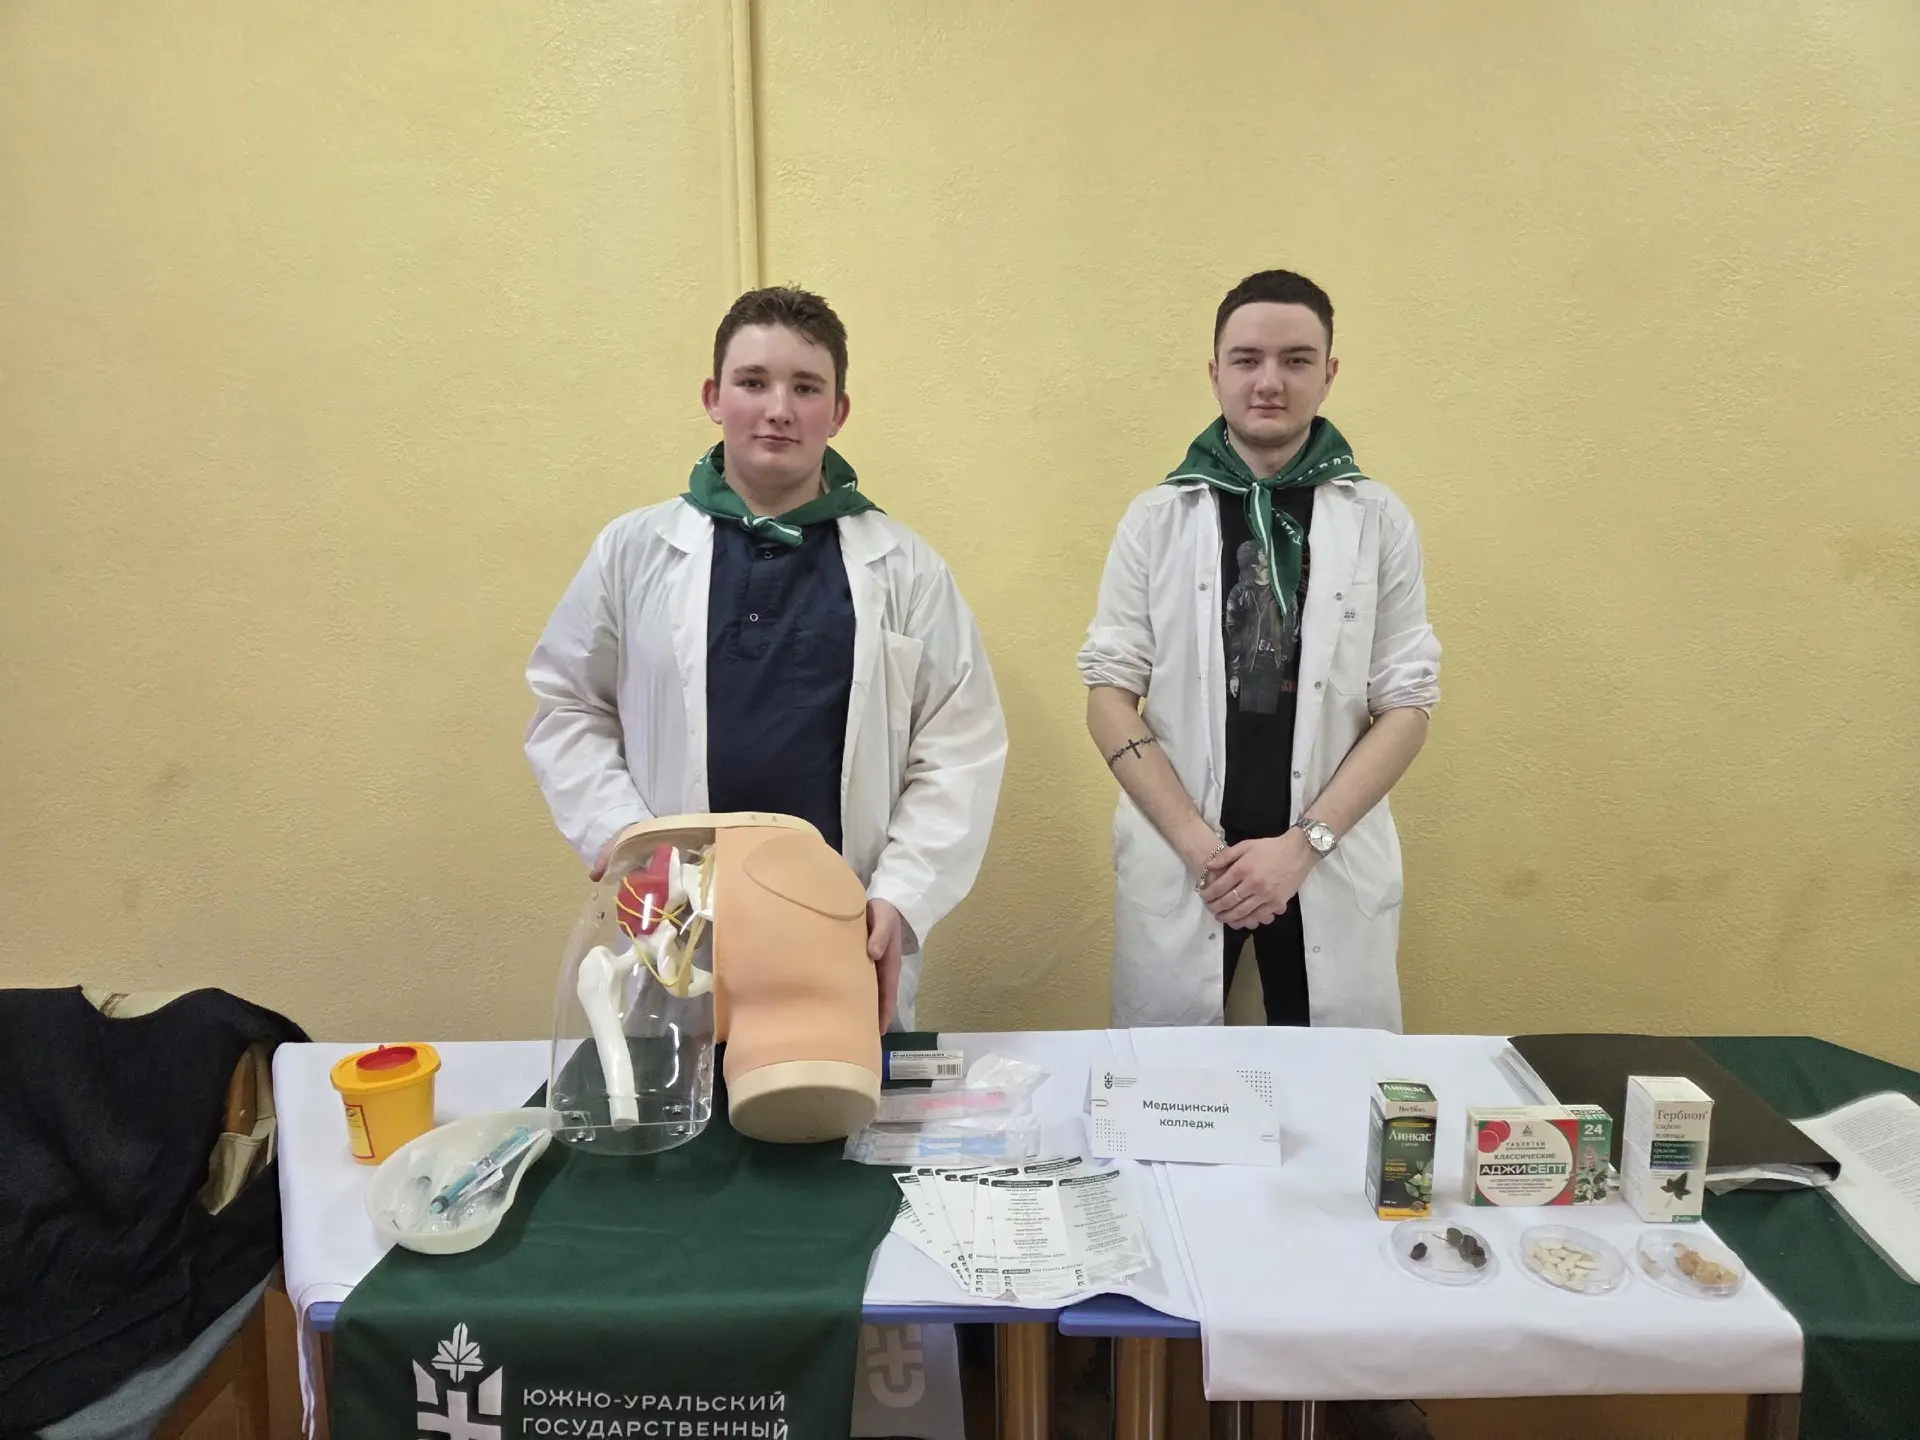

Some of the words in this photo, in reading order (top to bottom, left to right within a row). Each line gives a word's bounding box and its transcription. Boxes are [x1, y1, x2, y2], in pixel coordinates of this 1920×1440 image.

[1142, 1100, 1230, 1115] Медицинский
[1657, 1109, 1706, 1122] Гербион
[1159, 1117, 1215, 1130] колледж
[1584, 1123, 1604, 1135] 24
[1388, 1129, 1432, 1142] Линкас
[1481, 1164, 1566, 1176] АДЖИСЕПТ
[523, 1389, 786, 1412] ЮЖНО-УРАЛЬСКИЙ
[522, 1417, 789, 1440] ГОСУДАРСТВЕННЫЙ
